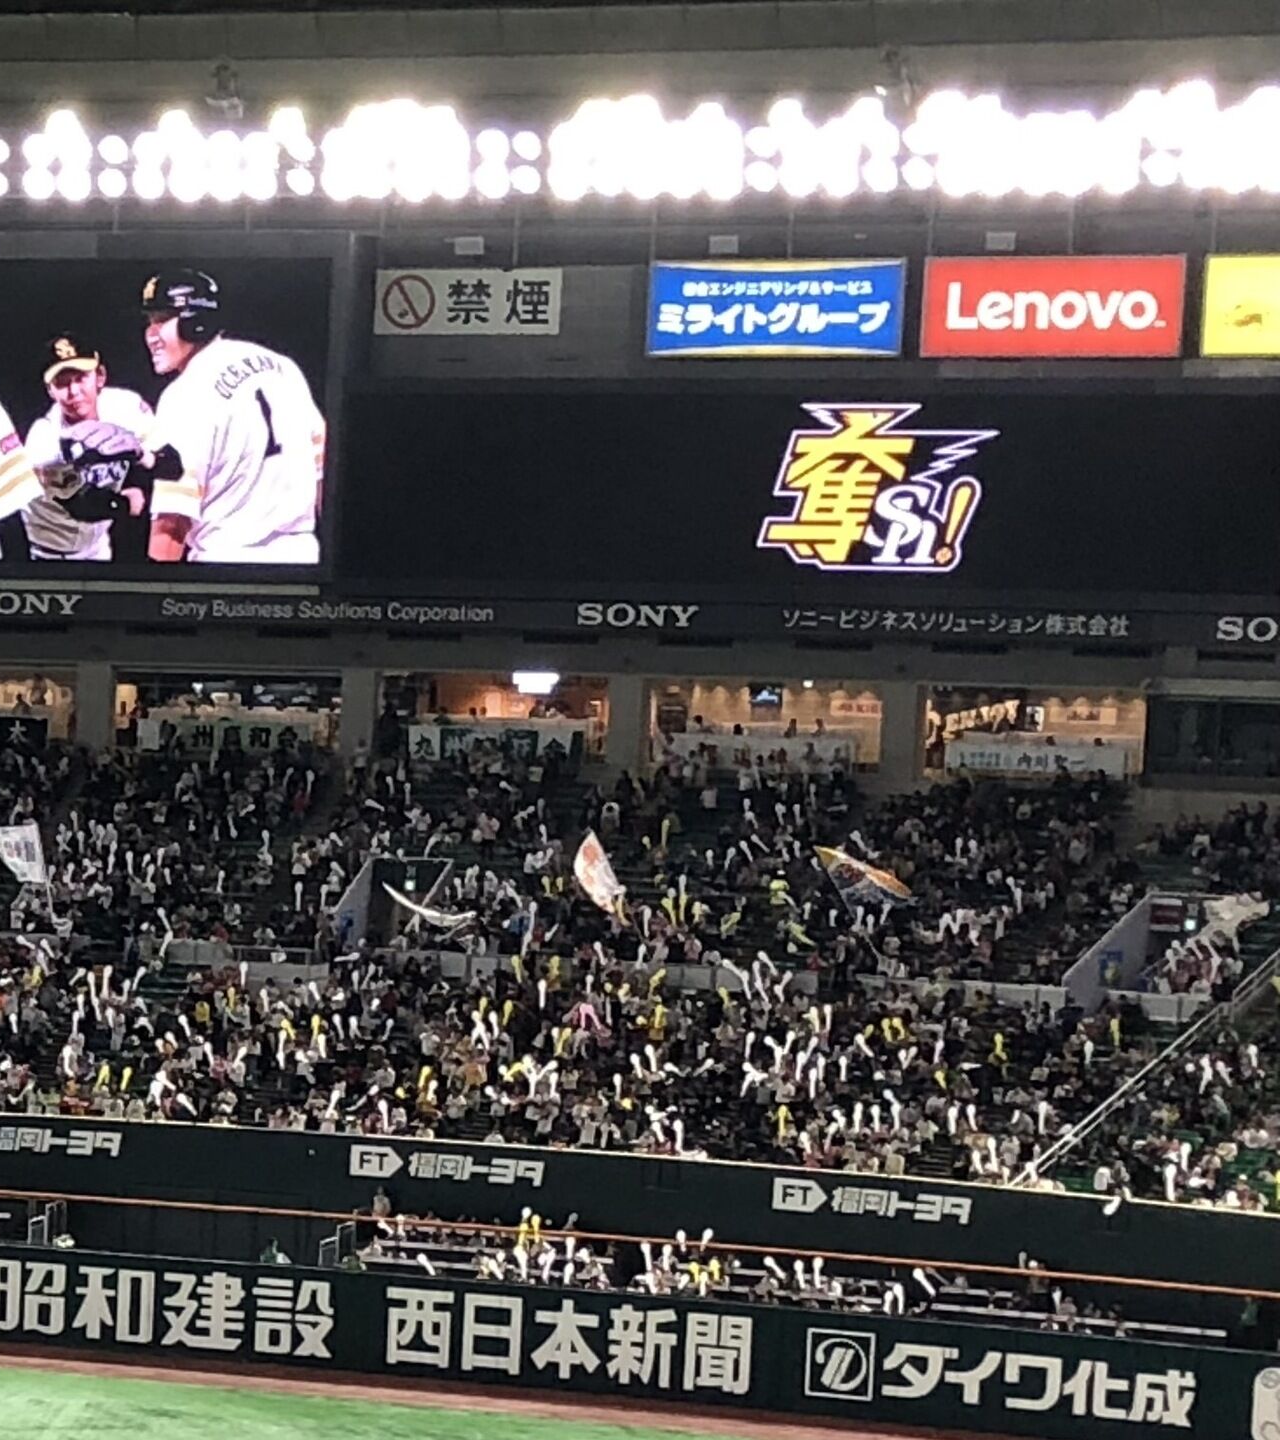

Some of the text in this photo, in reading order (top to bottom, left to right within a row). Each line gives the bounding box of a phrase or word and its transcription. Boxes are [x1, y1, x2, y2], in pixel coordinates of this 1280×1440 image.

[446, 279, 551, 325] 禁煙
[656, 301, 890, 334] ミライトグループ
[945, 281, 1158, 330] Lenovo
[161, 599, 494, 626] Sony Business Solutions Corporation
[577, 602, 700, 628] SONY
[782, 608, 1130, 638] ソニービジネスソリューション株式会社
[408, 1150, 544, 1186] 福岡トヨタ
[832, 1184, 973, 1224] 福岡トヨタ
[386, 1288, 753, 1395] 西日本新聞
[881, 1342, 1197, 1428] ダイワ化成
